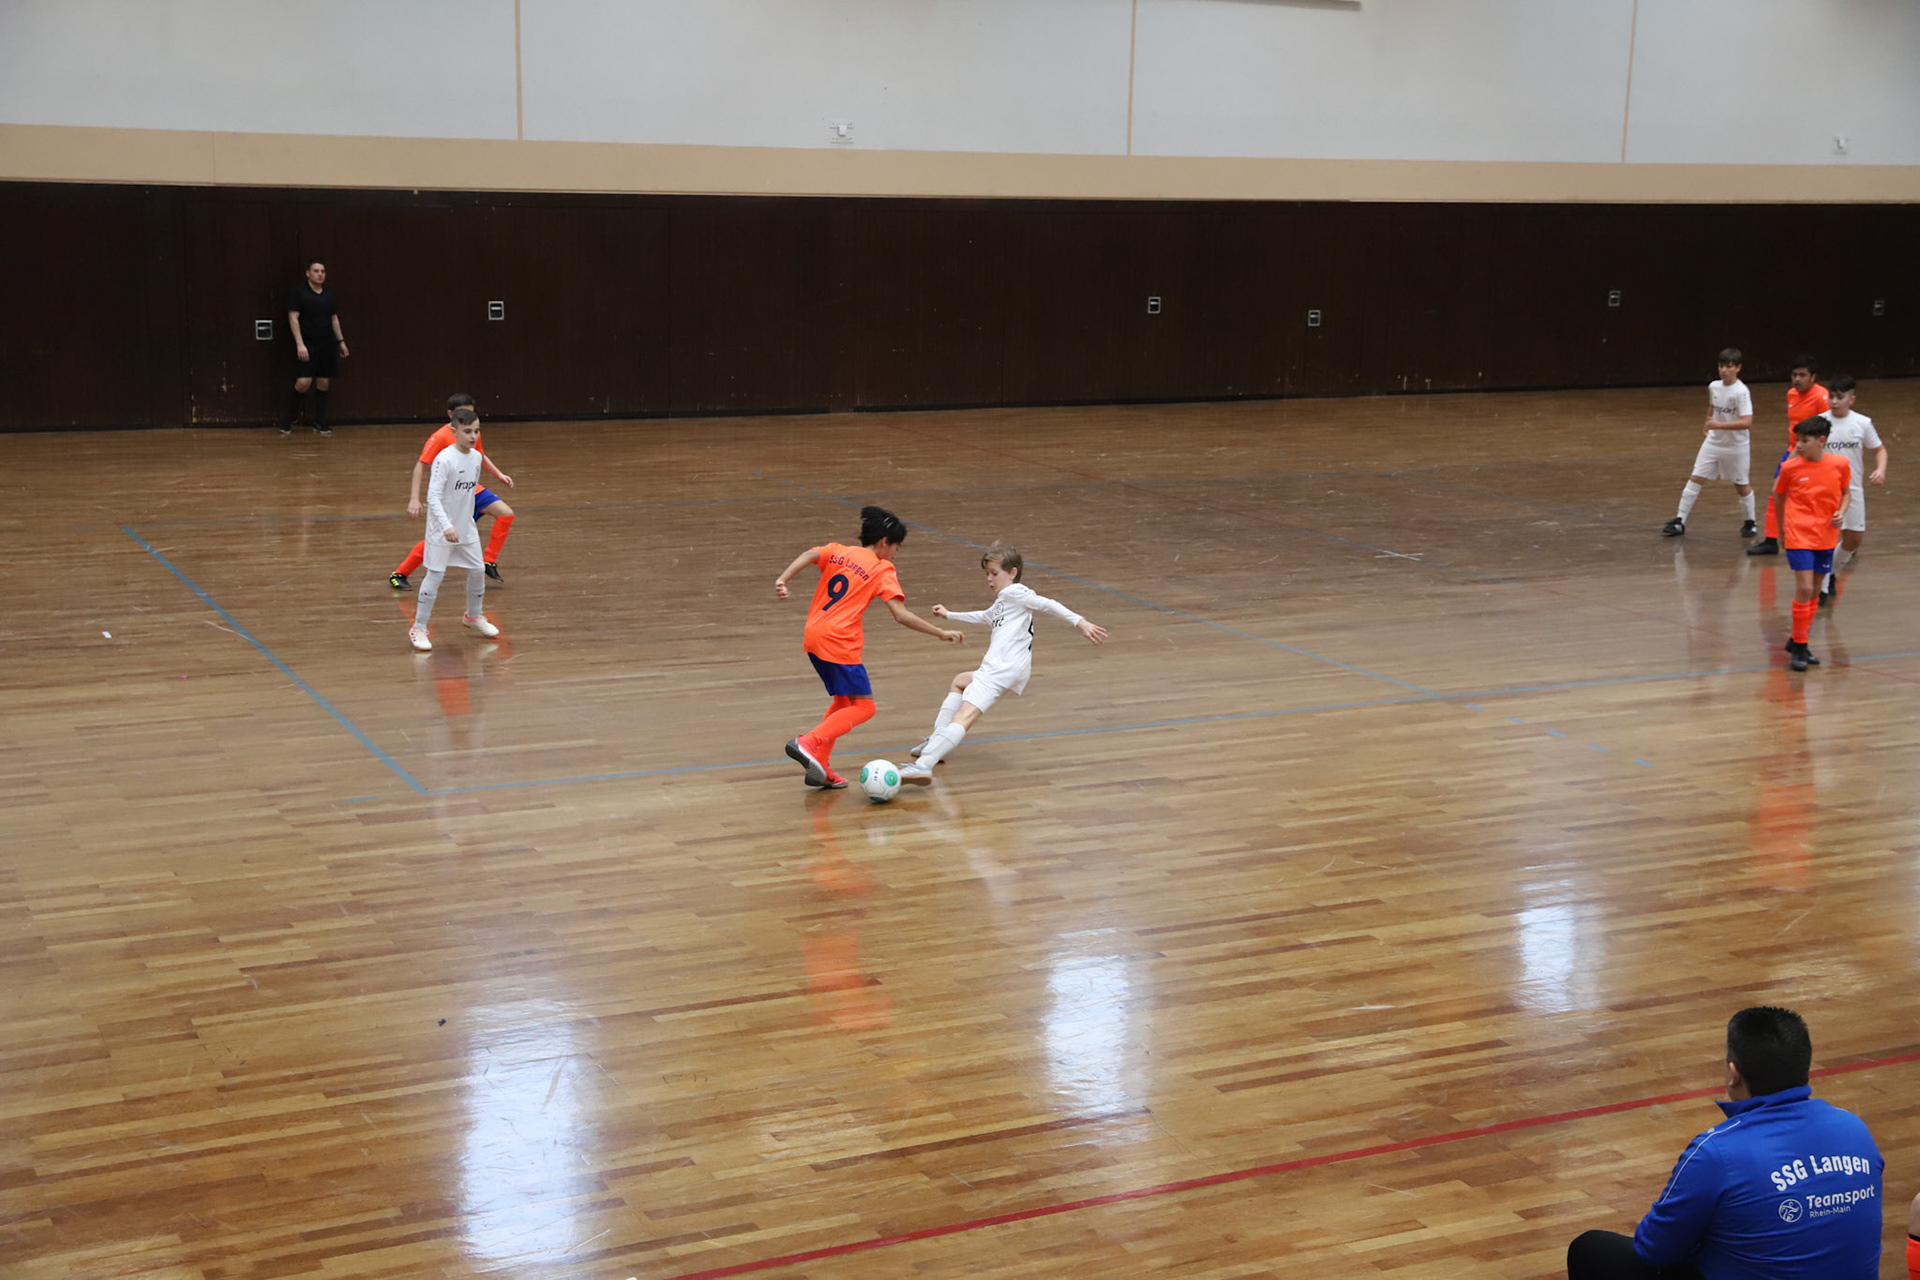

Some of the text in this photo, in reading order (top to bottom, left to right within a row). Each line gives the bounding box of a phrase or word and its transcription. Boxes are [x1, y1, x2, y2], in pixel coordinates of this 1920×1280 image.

[1825, 441, 1859, 451] raport
[829, 555, 870, 581] SSG Langen
[822, 573, 849, 611] 9
[1770, 1155, 1870, 1192] SSG Langen
[1806, 1184, 1875, 1209] Teamsport
[1809, 1205, 1851, 1219] Rhein-Main
